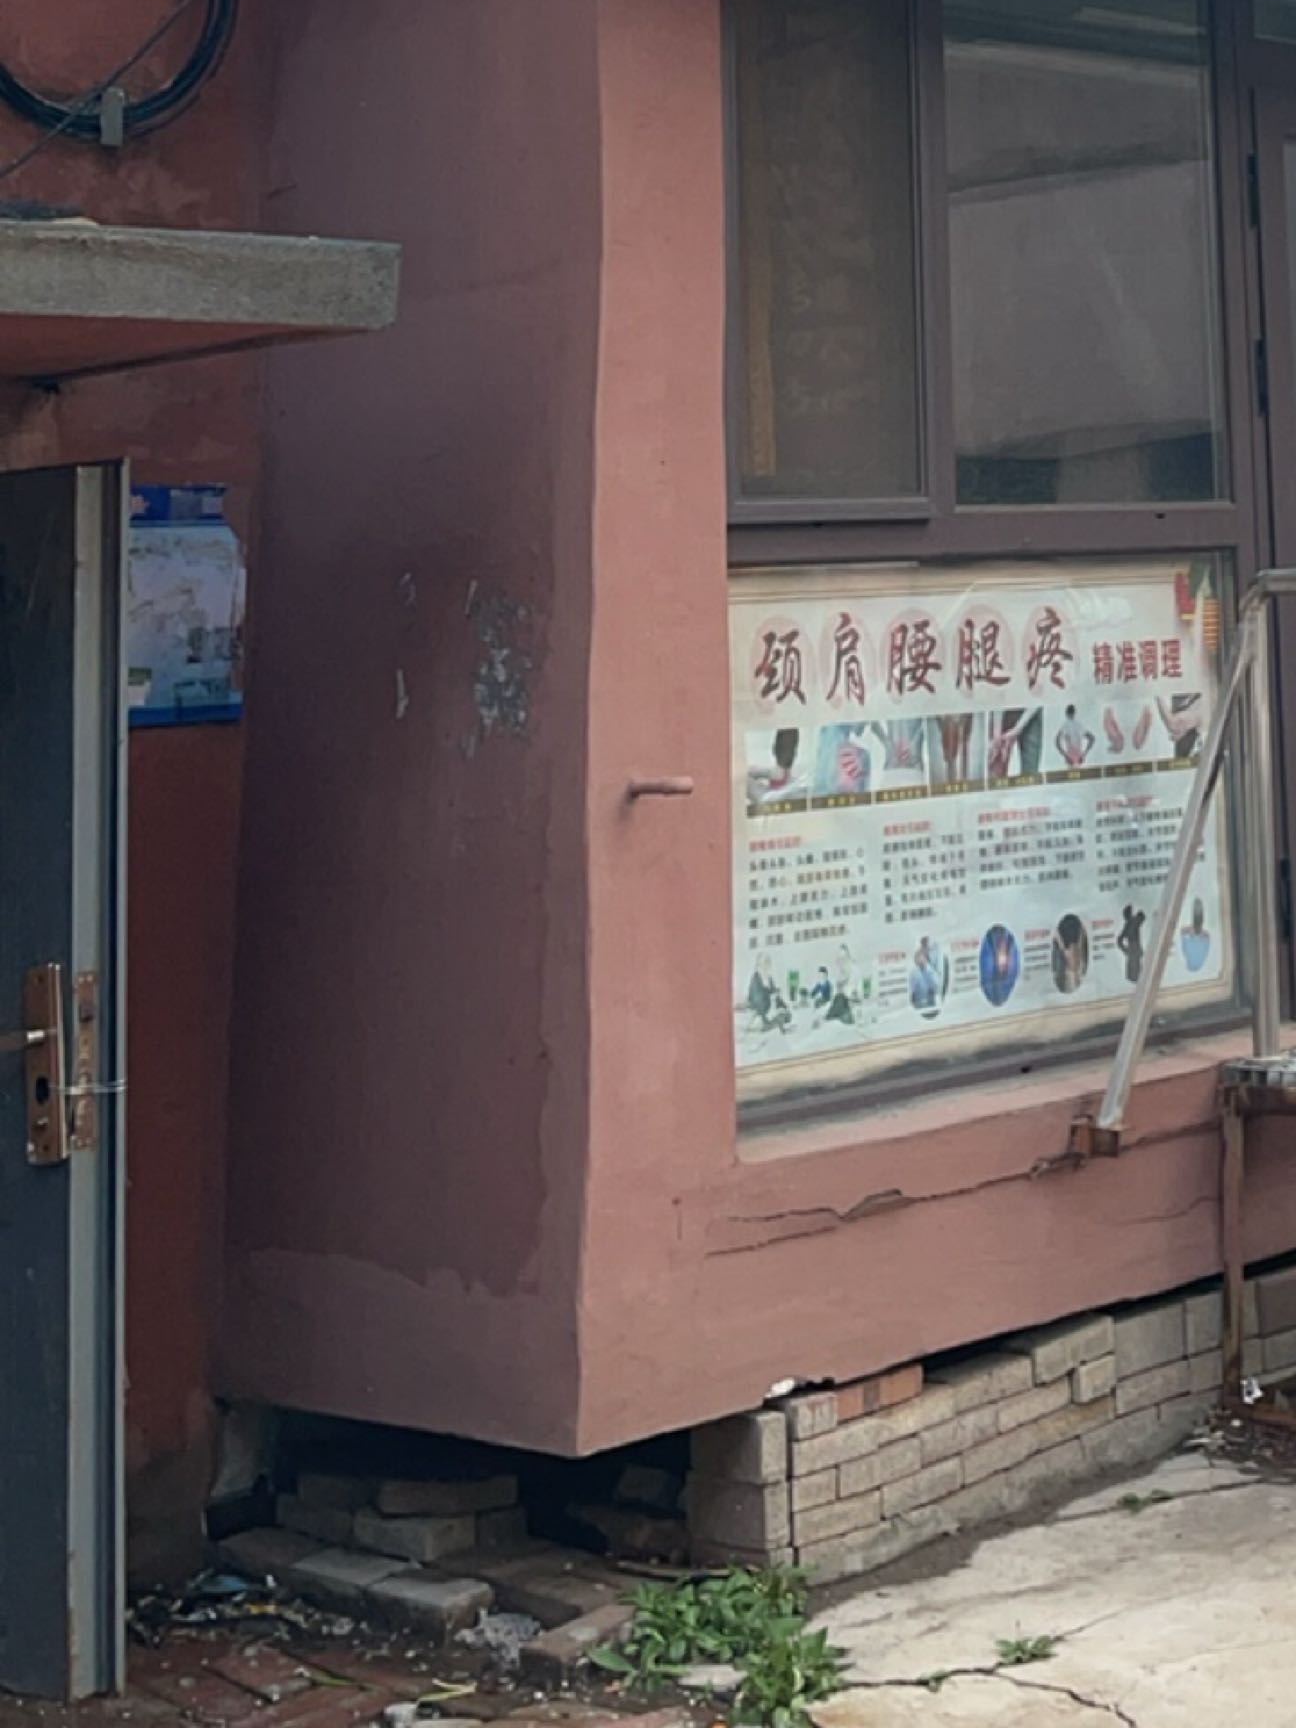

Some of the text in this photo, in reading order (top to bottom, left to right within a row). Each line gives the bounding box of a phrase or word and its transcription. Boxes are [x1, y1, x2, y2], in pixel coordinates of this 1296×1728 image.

[754, 606, 1074, 707] 颈肩腰腿疼
